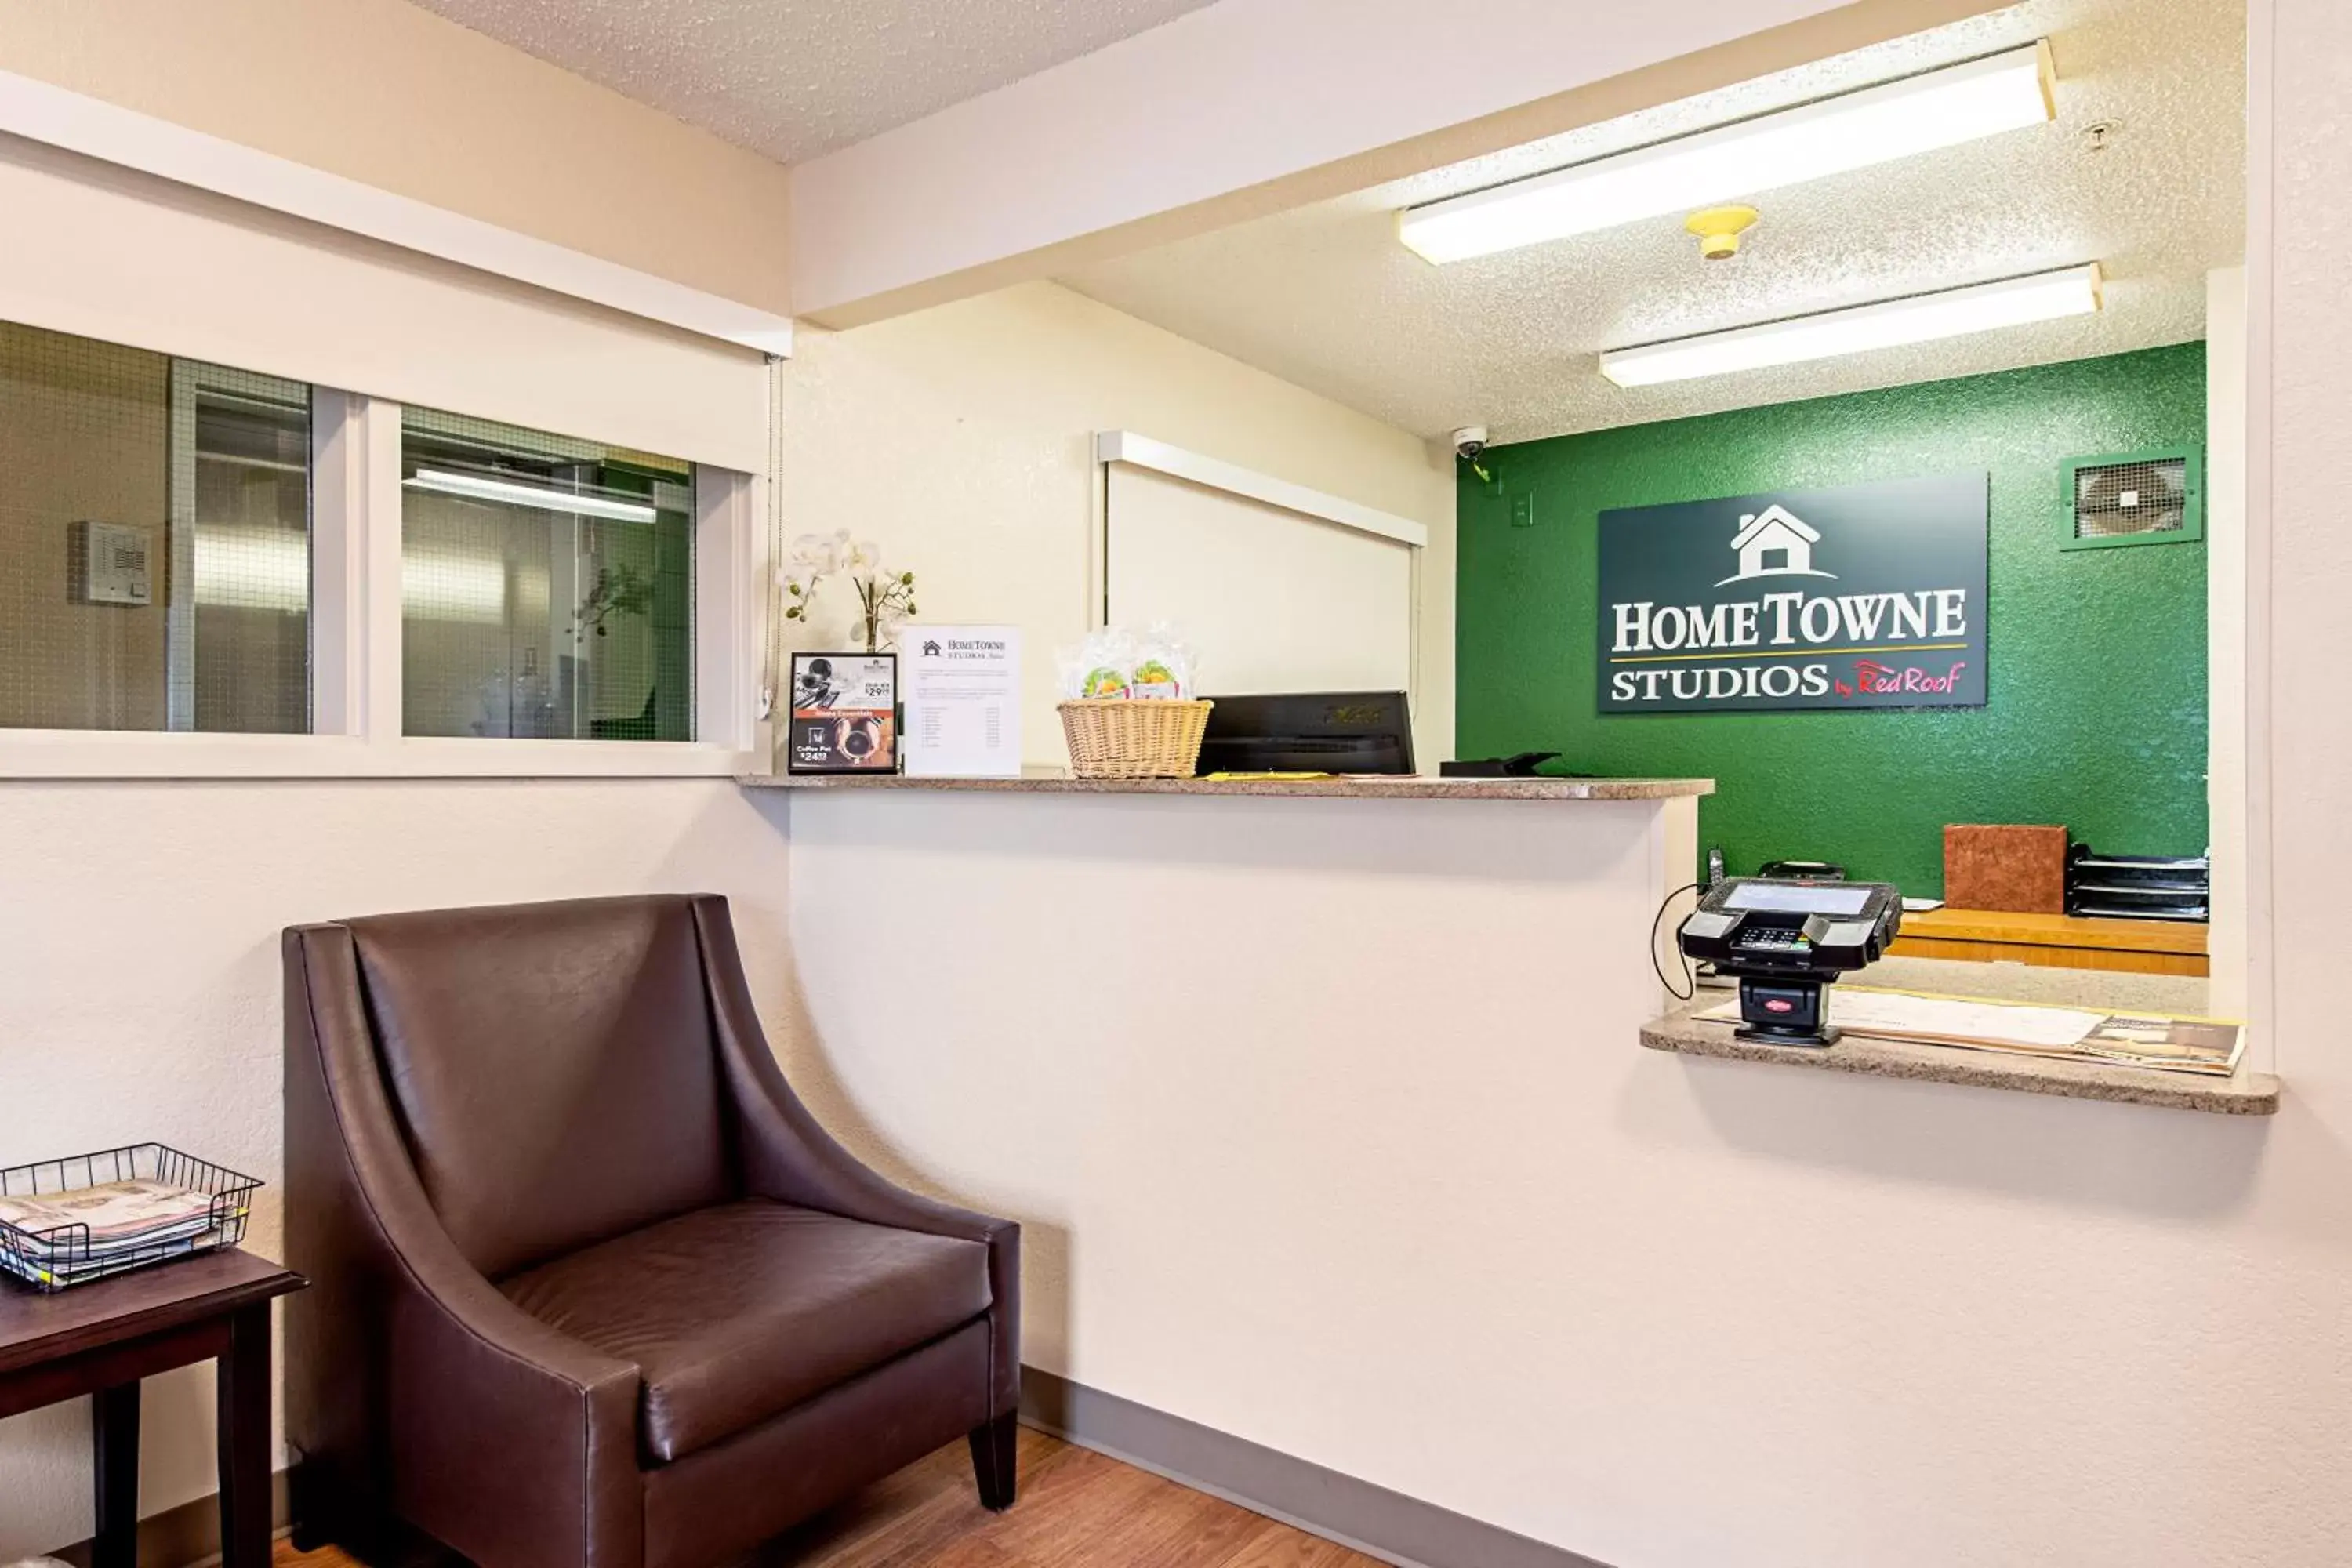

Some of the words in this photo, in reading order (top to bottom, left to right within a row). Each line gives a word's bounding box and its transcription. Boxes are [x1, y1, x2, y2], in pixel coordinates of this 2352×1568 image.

[1611, 588, 1967, 652] HOMETOWNE
[1611, 663, 1829, 701] STUDIOS
[1834, 677, 1853, 699] by
